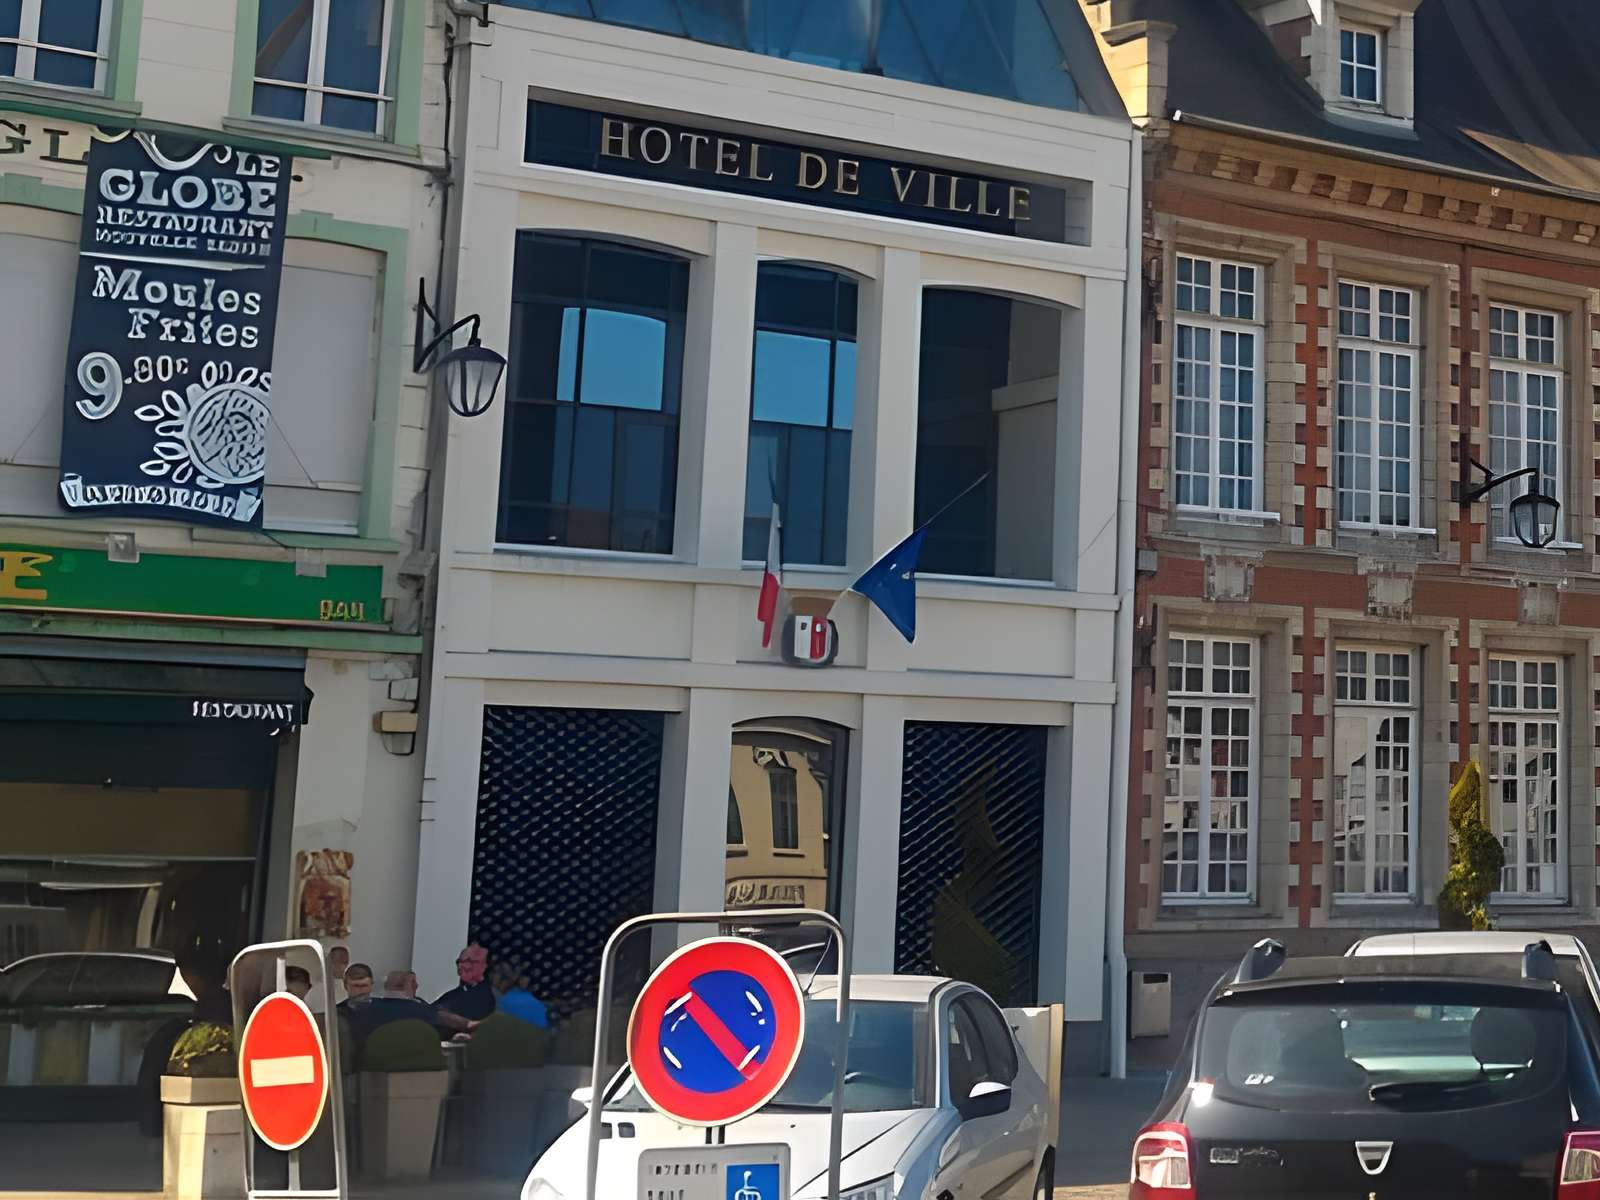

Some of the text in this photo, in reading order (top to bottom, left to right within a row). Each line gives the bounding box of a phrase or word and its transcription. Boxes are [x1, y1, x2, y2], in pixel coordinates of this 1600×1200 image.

[235, 151, 281, 178] LE
[600, 117, 1032, 221] HOTEL DE VILLE
[99, 167, 278, 217] GLOBE
[91, 265, 262, 315] Moules
[127, 307, 259, 349] Frites
